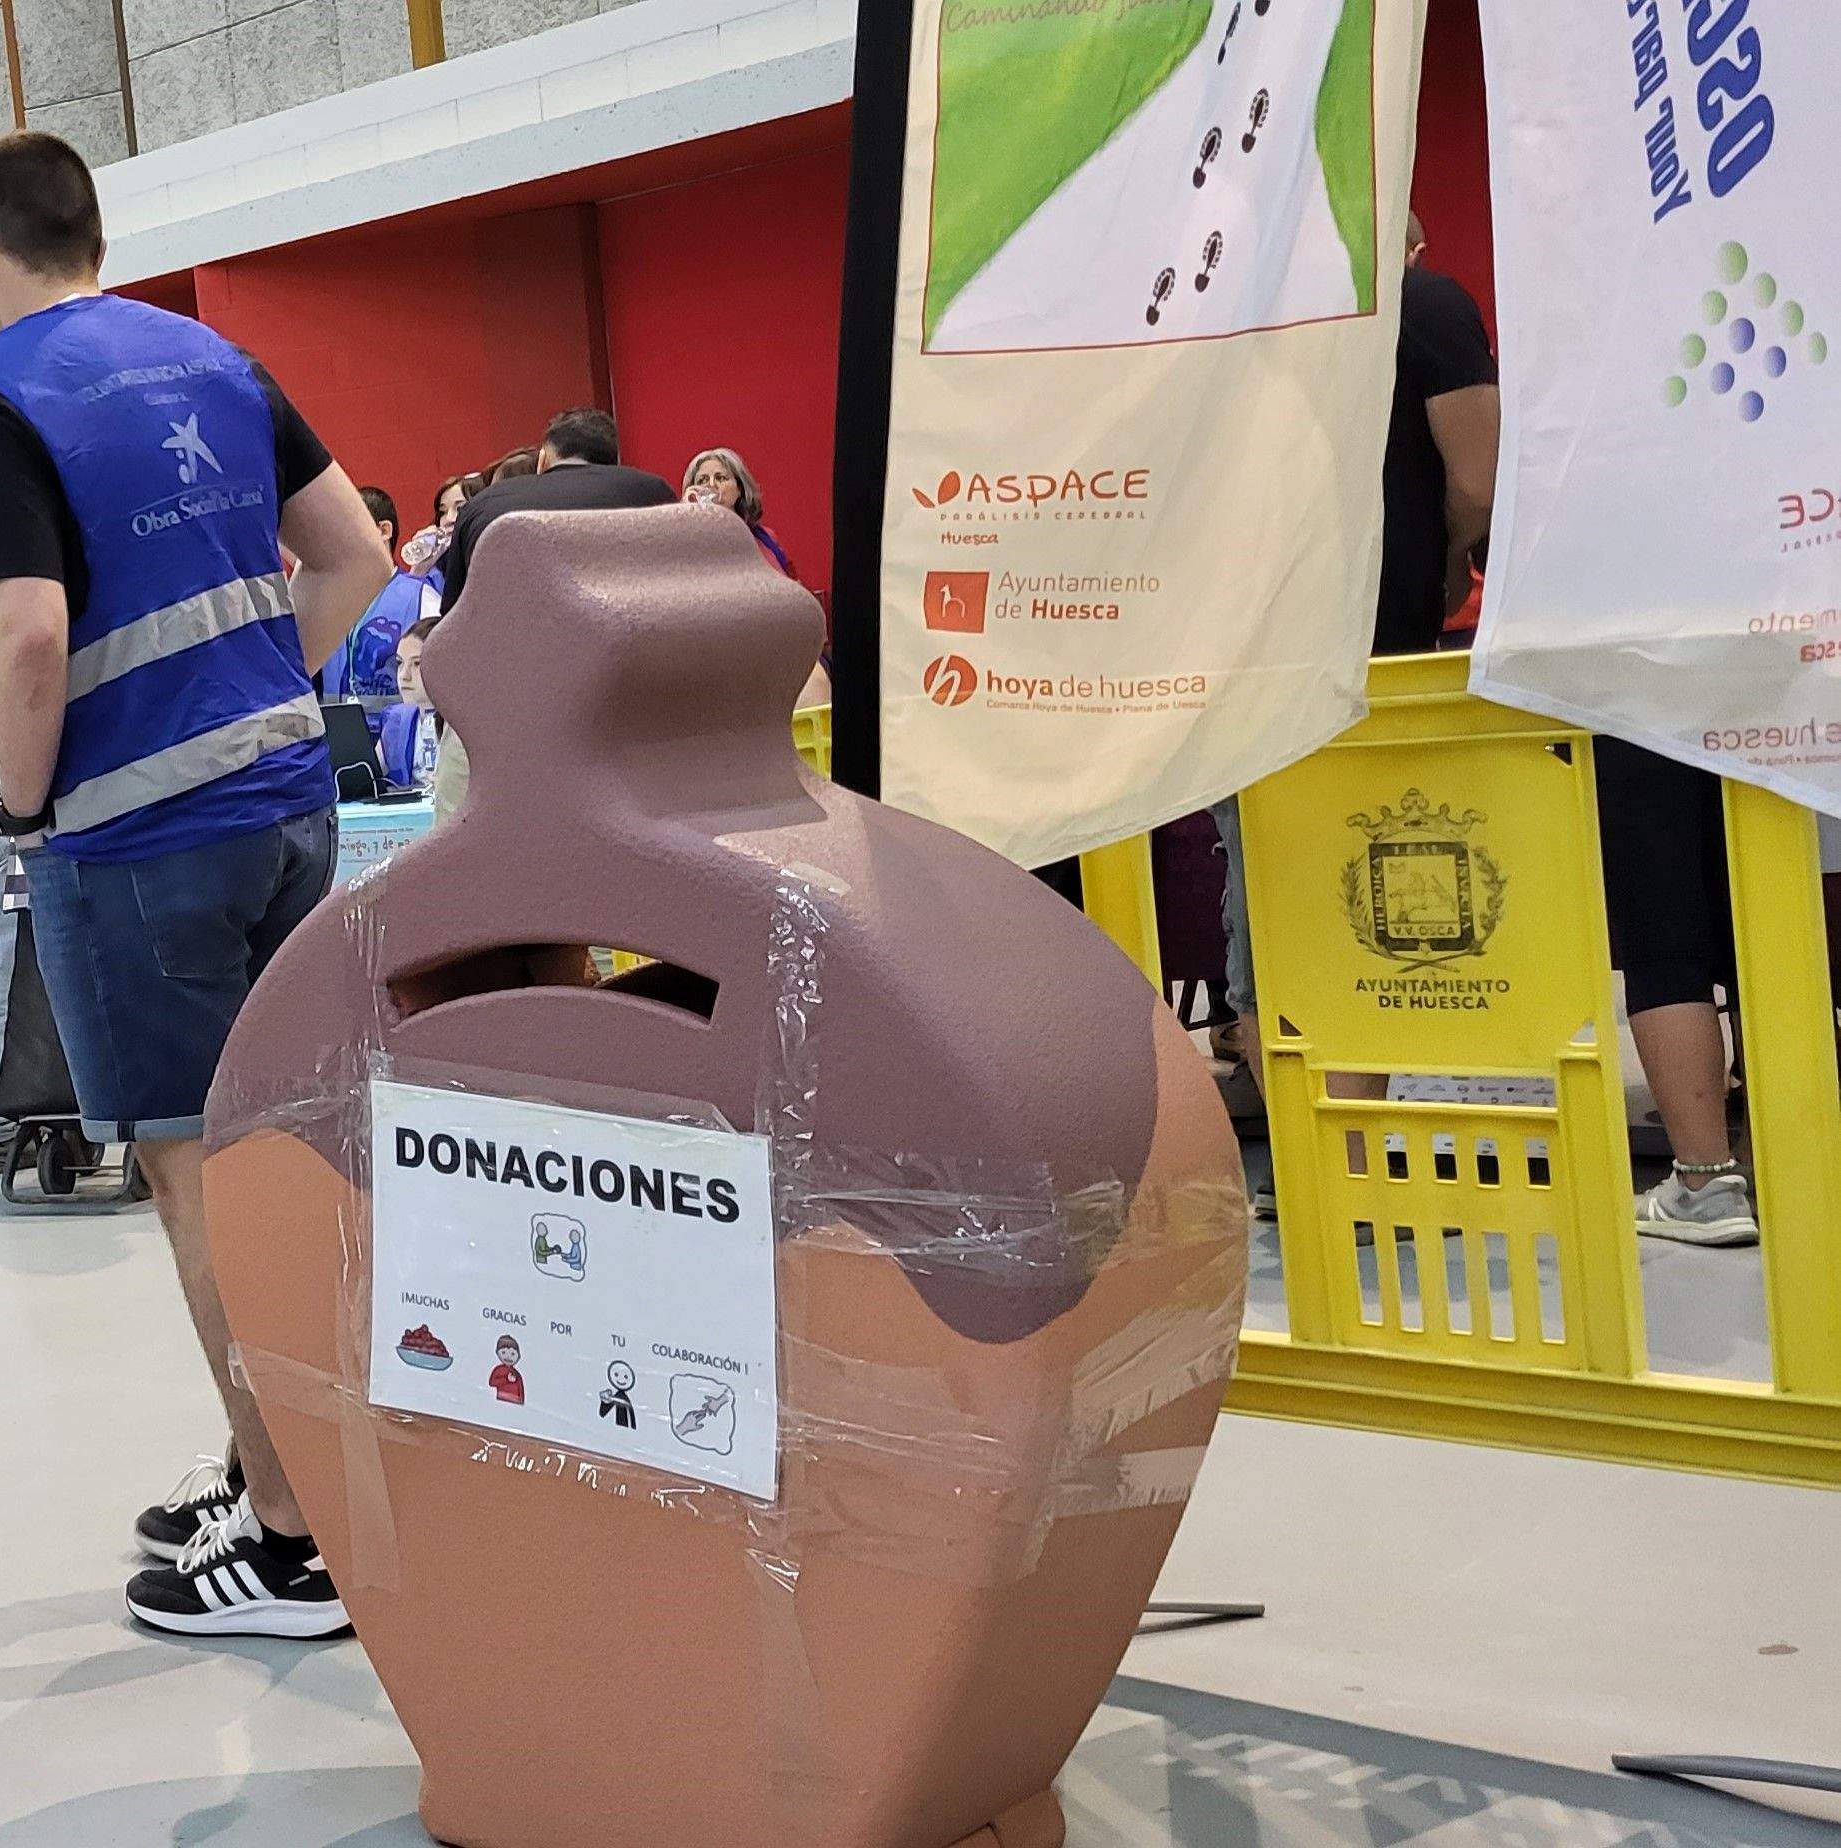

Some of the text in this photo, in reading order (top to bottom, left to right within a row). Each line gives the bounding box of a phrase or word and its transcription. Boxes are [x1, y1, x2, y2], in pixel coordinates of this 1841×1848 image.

[967, 468, 1150, 508] ASPACE
[131, 510, 182, 538] Obra
[941, 530, 999, 545] Huesca
[998, 570, 1161, 598] Ayuntamiento
[994, 598, 1120, 620] de Huesca
[987, 670, 1206, 700] hoya de huesca
[1418, 926, 1456, 937] OSCA
[1355, 979, 1511, 994] AYUNTAMIENTO
[1378, 995, 1490, 1010] DE HUESCA
[395, 1126, 741, 1224] DONACIONES
[482, 1307, 527, 1327] GRACIAS
[550, 1321, 572, 1336] POR
[611, 1334, 626, 1348] TU
[651, 1343, 741, 1375] COLABORACIÓN
